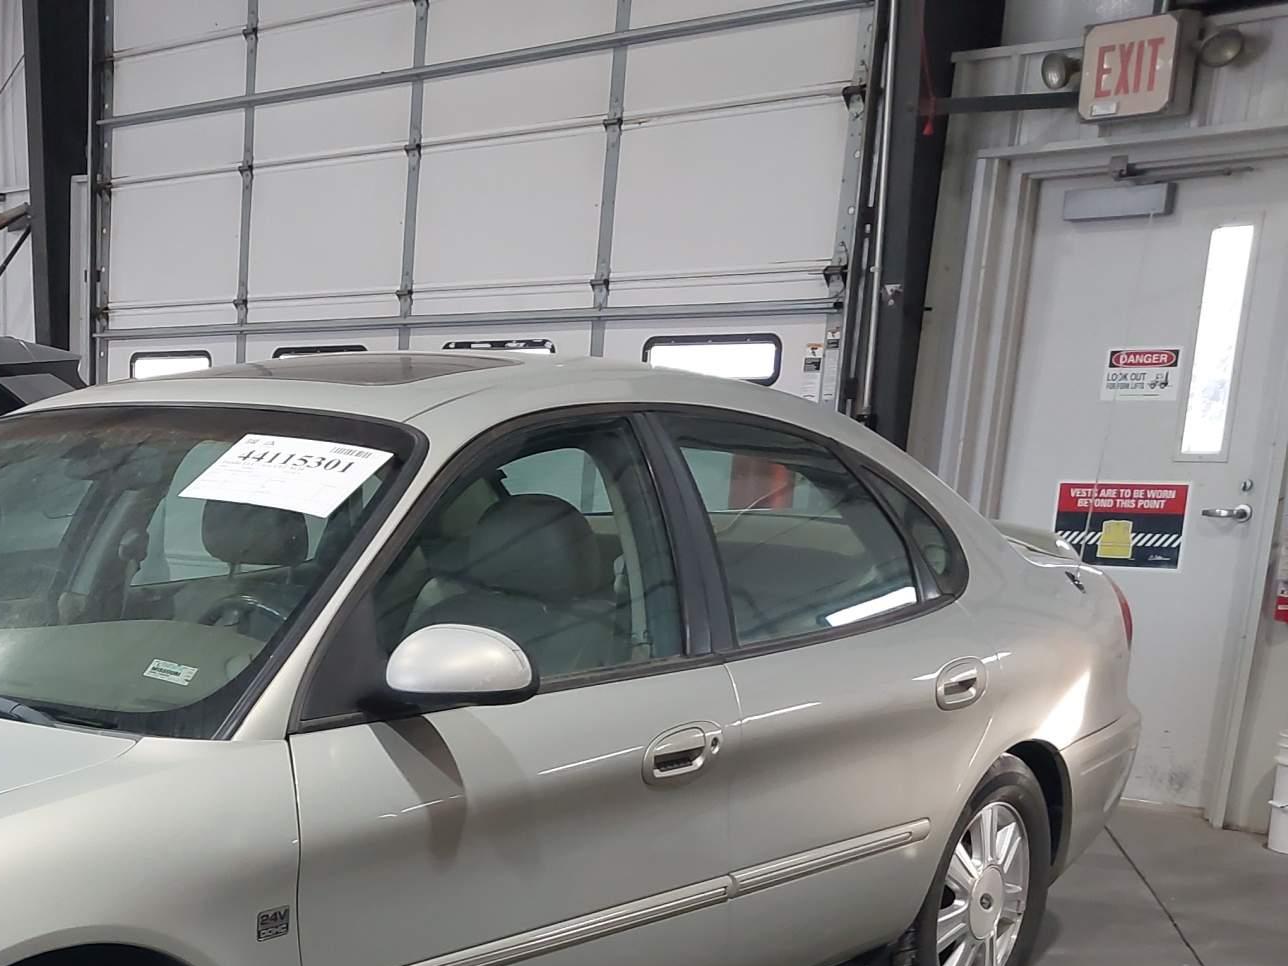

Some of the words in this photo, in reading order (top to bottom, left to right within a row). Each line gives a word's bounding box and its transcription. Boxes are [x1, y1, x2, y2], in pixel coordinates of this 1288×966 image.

[1094, 37, 1165, 98] EXIT
[1119, 353, 1169, 364] DANGER
[1130, 372, 1146, 381] OUT
[237, 449, 356, 474] 44115301
[1100, 488, 1117, 498] ARE
[1119, 489, 1132, 498] TO
[1133, 489, 1145, 498] BE
[1146, 489, 1177, 499] WORN
[1116, 499, 1136, 508] THIS
[1137, 500, 1166, 509] POINT
[261, 909, 288, 925] 24V
